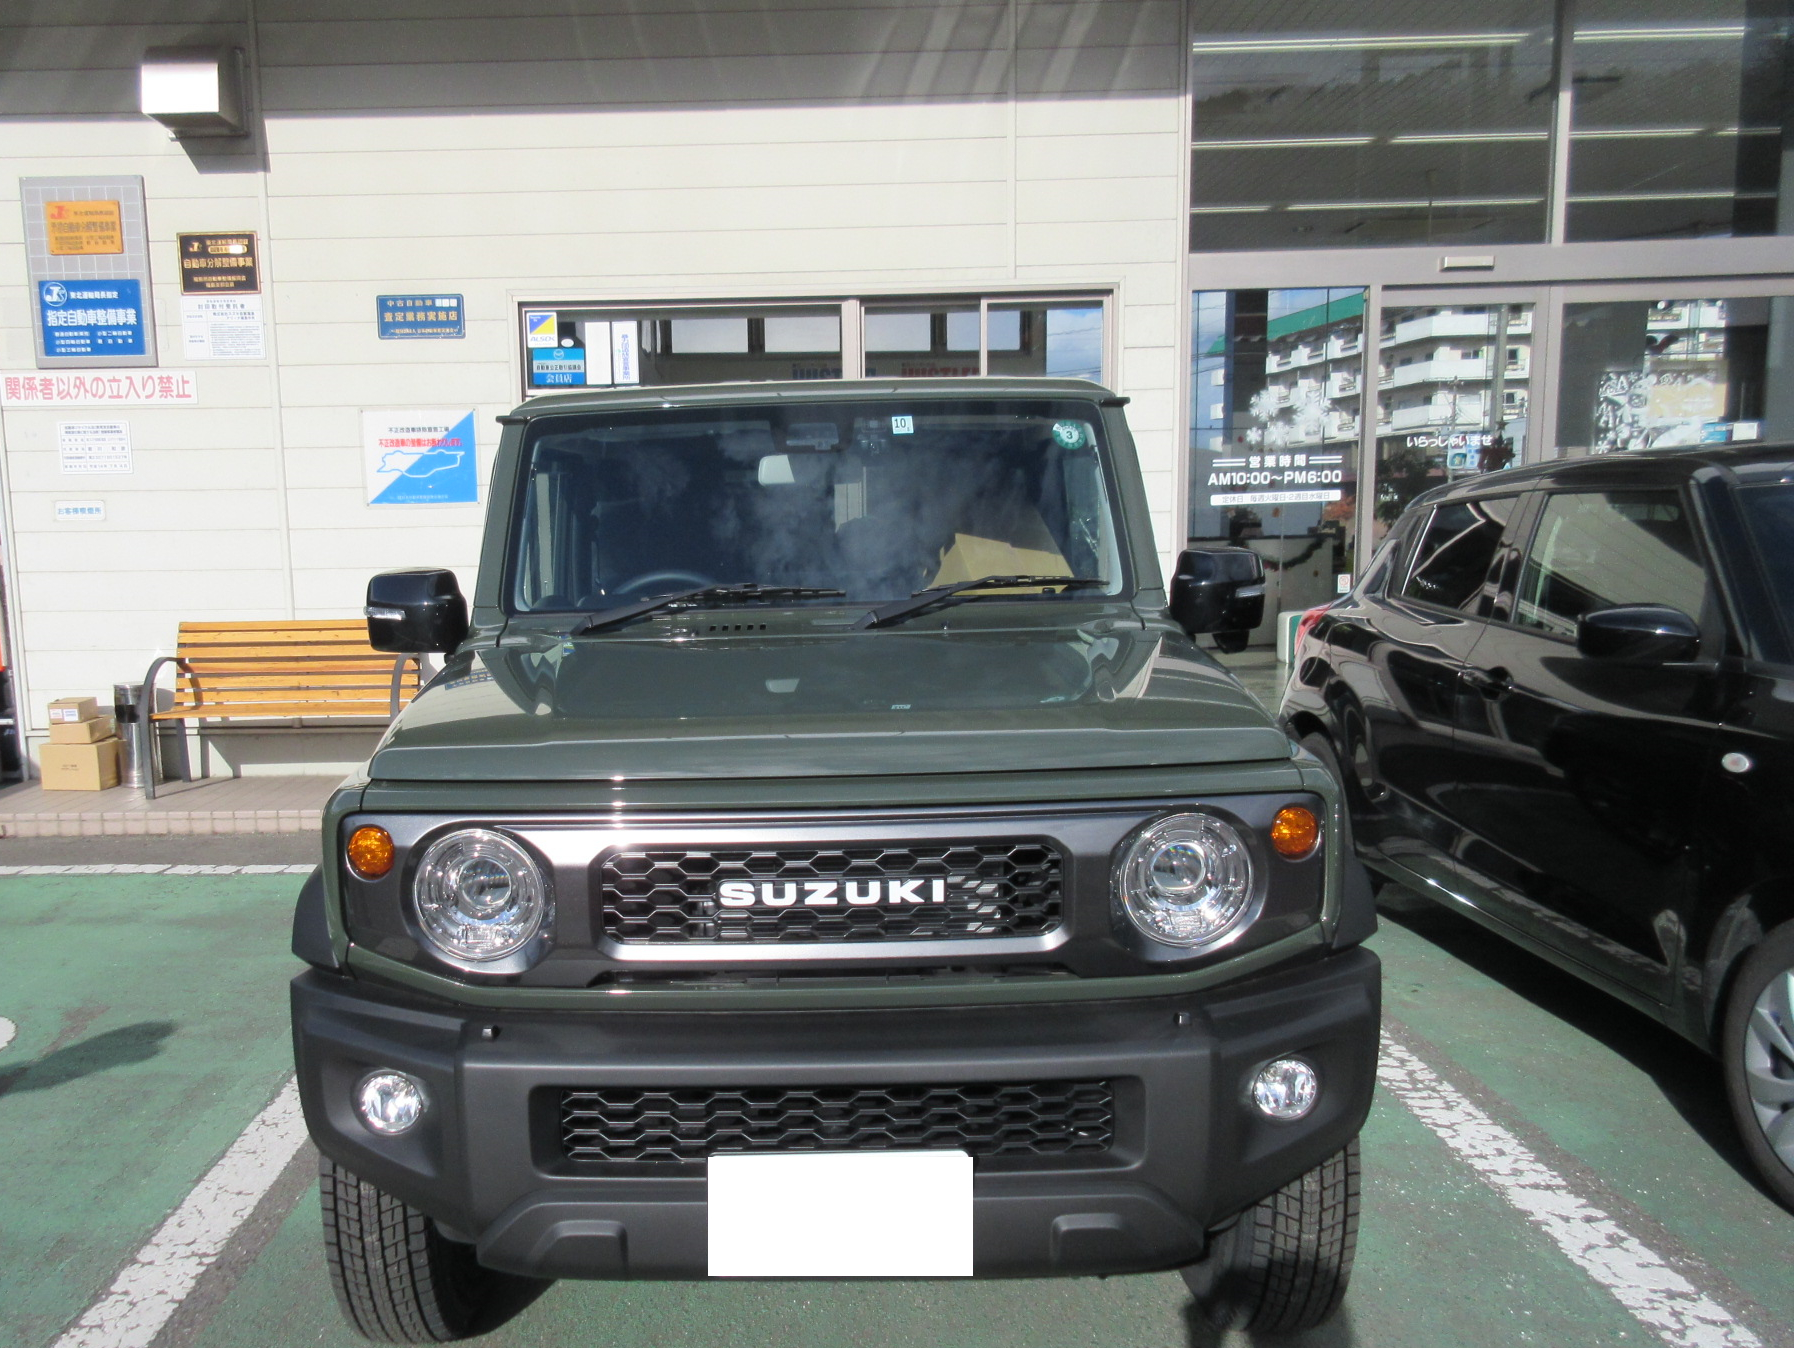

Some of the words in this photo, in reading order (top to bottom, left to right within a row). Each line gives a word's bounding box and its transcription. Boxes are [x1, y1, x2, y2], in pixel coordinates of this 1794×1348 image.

[183, 257, 254, 269] 自動車分解整備事業
[47, 308, 138, 327] 指定自動車整備事業
[384, 311, 458, 322] 査定業務実施店
[546, 373, 573, 384] 会員店
[5, 375, 192, 401] 関係者以外の立入り禁止
[894, 417, 907, 429] 10
[1406, 434, 1493, 448] いらっしゃいませ
[1248, 454, 1307, 468] 営業時間
[1222, 494, 1245, 503] 定休日
[719, 878, 946, 907] SUZUKI
